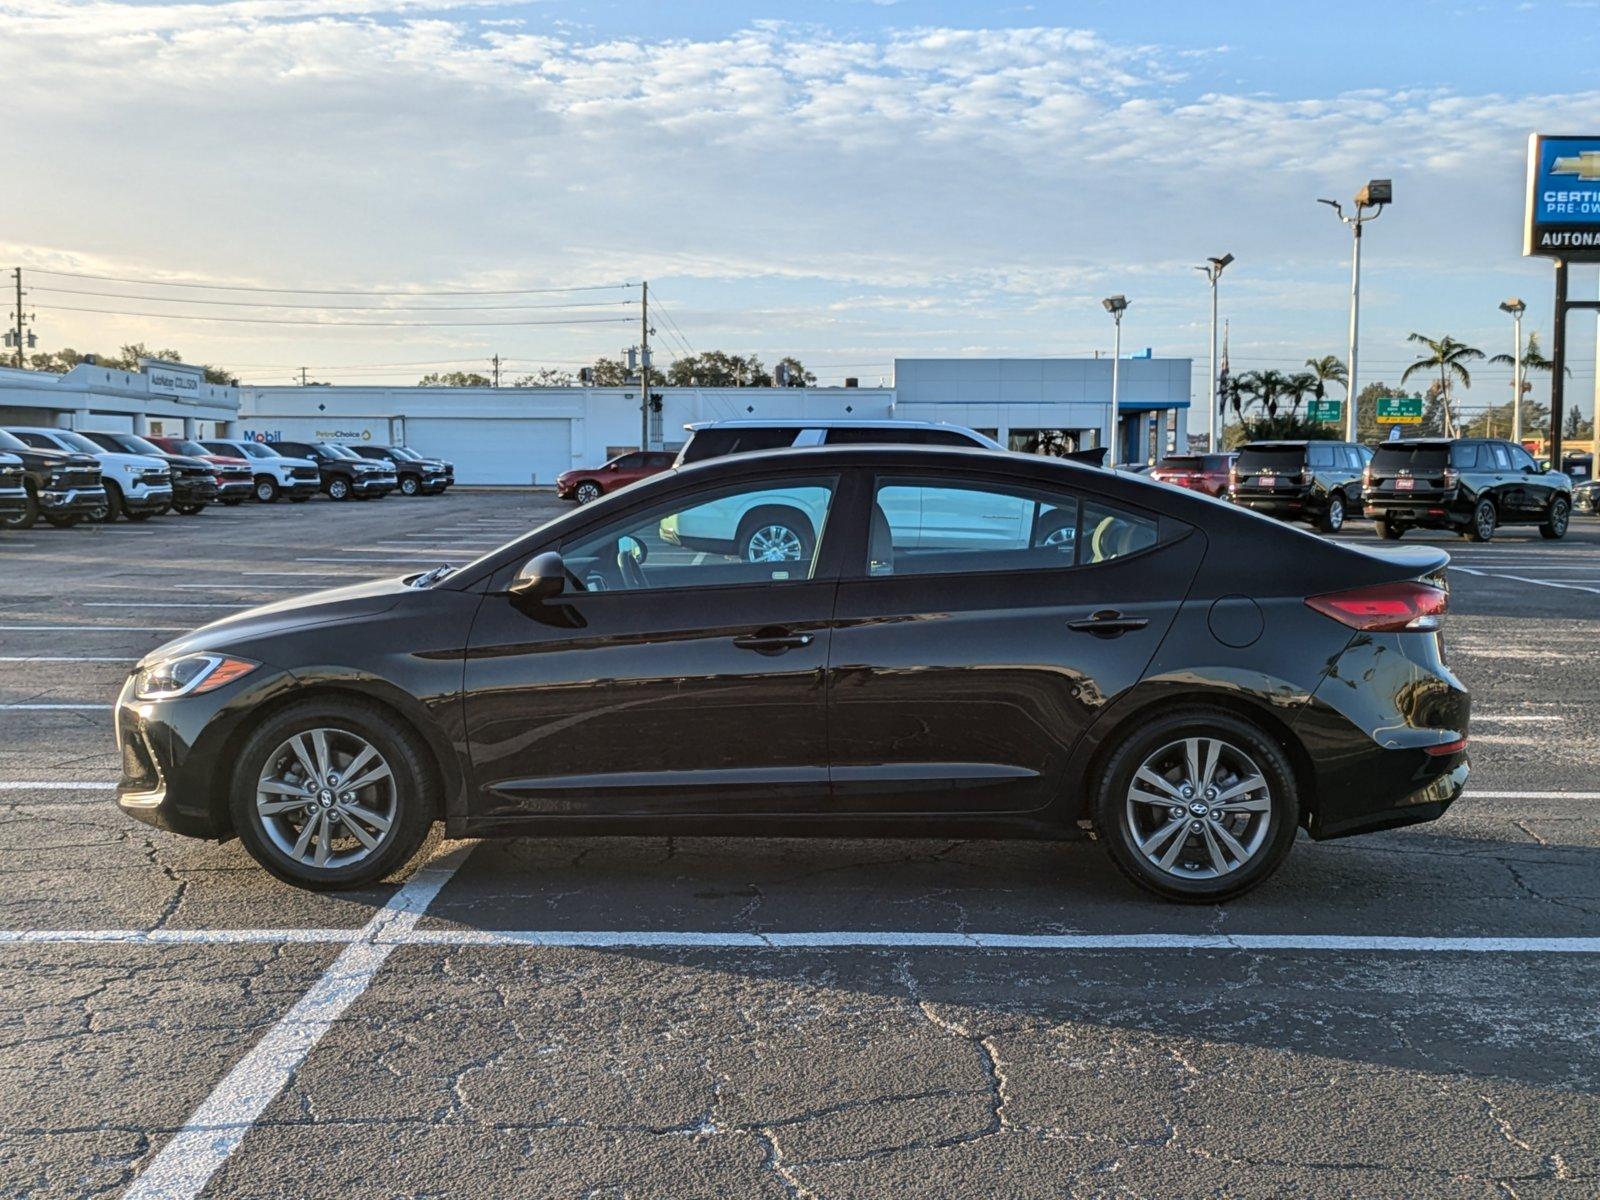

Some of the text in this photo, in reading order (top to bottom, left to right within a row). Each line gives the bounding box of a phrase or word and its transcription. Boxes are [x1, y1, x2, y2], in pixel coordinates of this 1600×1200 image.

[1543, 191, 1600, 202] CERTI
[1541, 232, 1600, 246] AUTONA
[244, 430, 281, 443] Mobil
